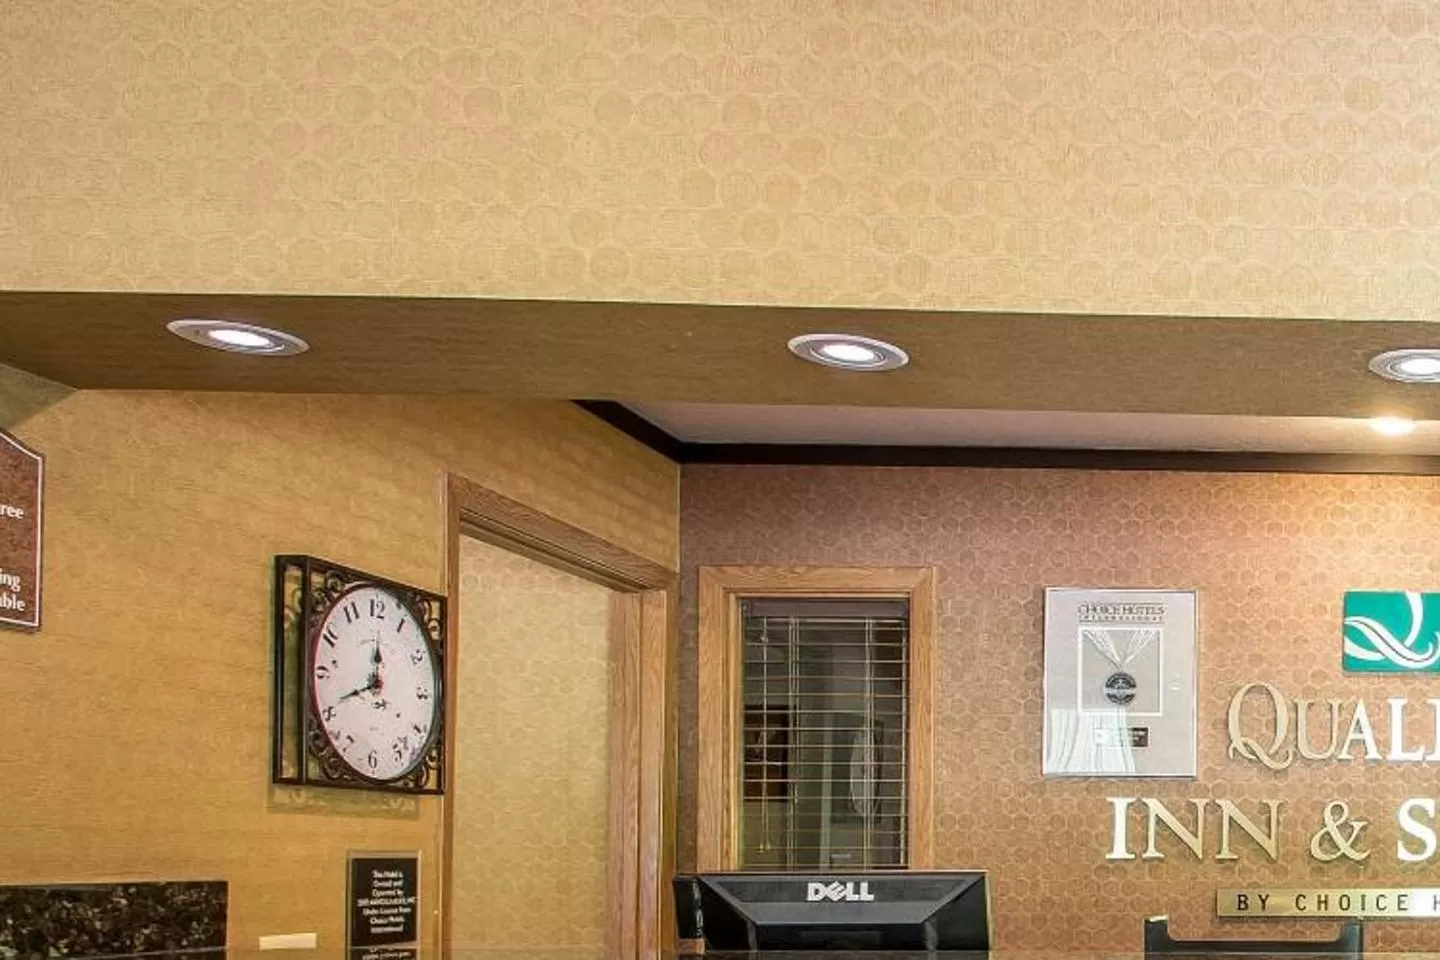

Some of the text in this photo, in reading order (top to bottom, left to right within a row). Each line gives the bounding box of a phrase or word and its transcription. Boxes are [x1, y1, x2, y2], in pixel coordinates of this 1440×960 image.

[343, 602, 360, 624] 11
[369, 599, 385, 620] 12
[367, 751, 378, 769] 6
[1104, 796, 1284, 862] INN
[1310, 799, 1371, 862] &
[808, 881, 874, 901] DELL
[1237, 895, 1270, 911] BY
[1295, 894, 1409, 911] CHOICE
